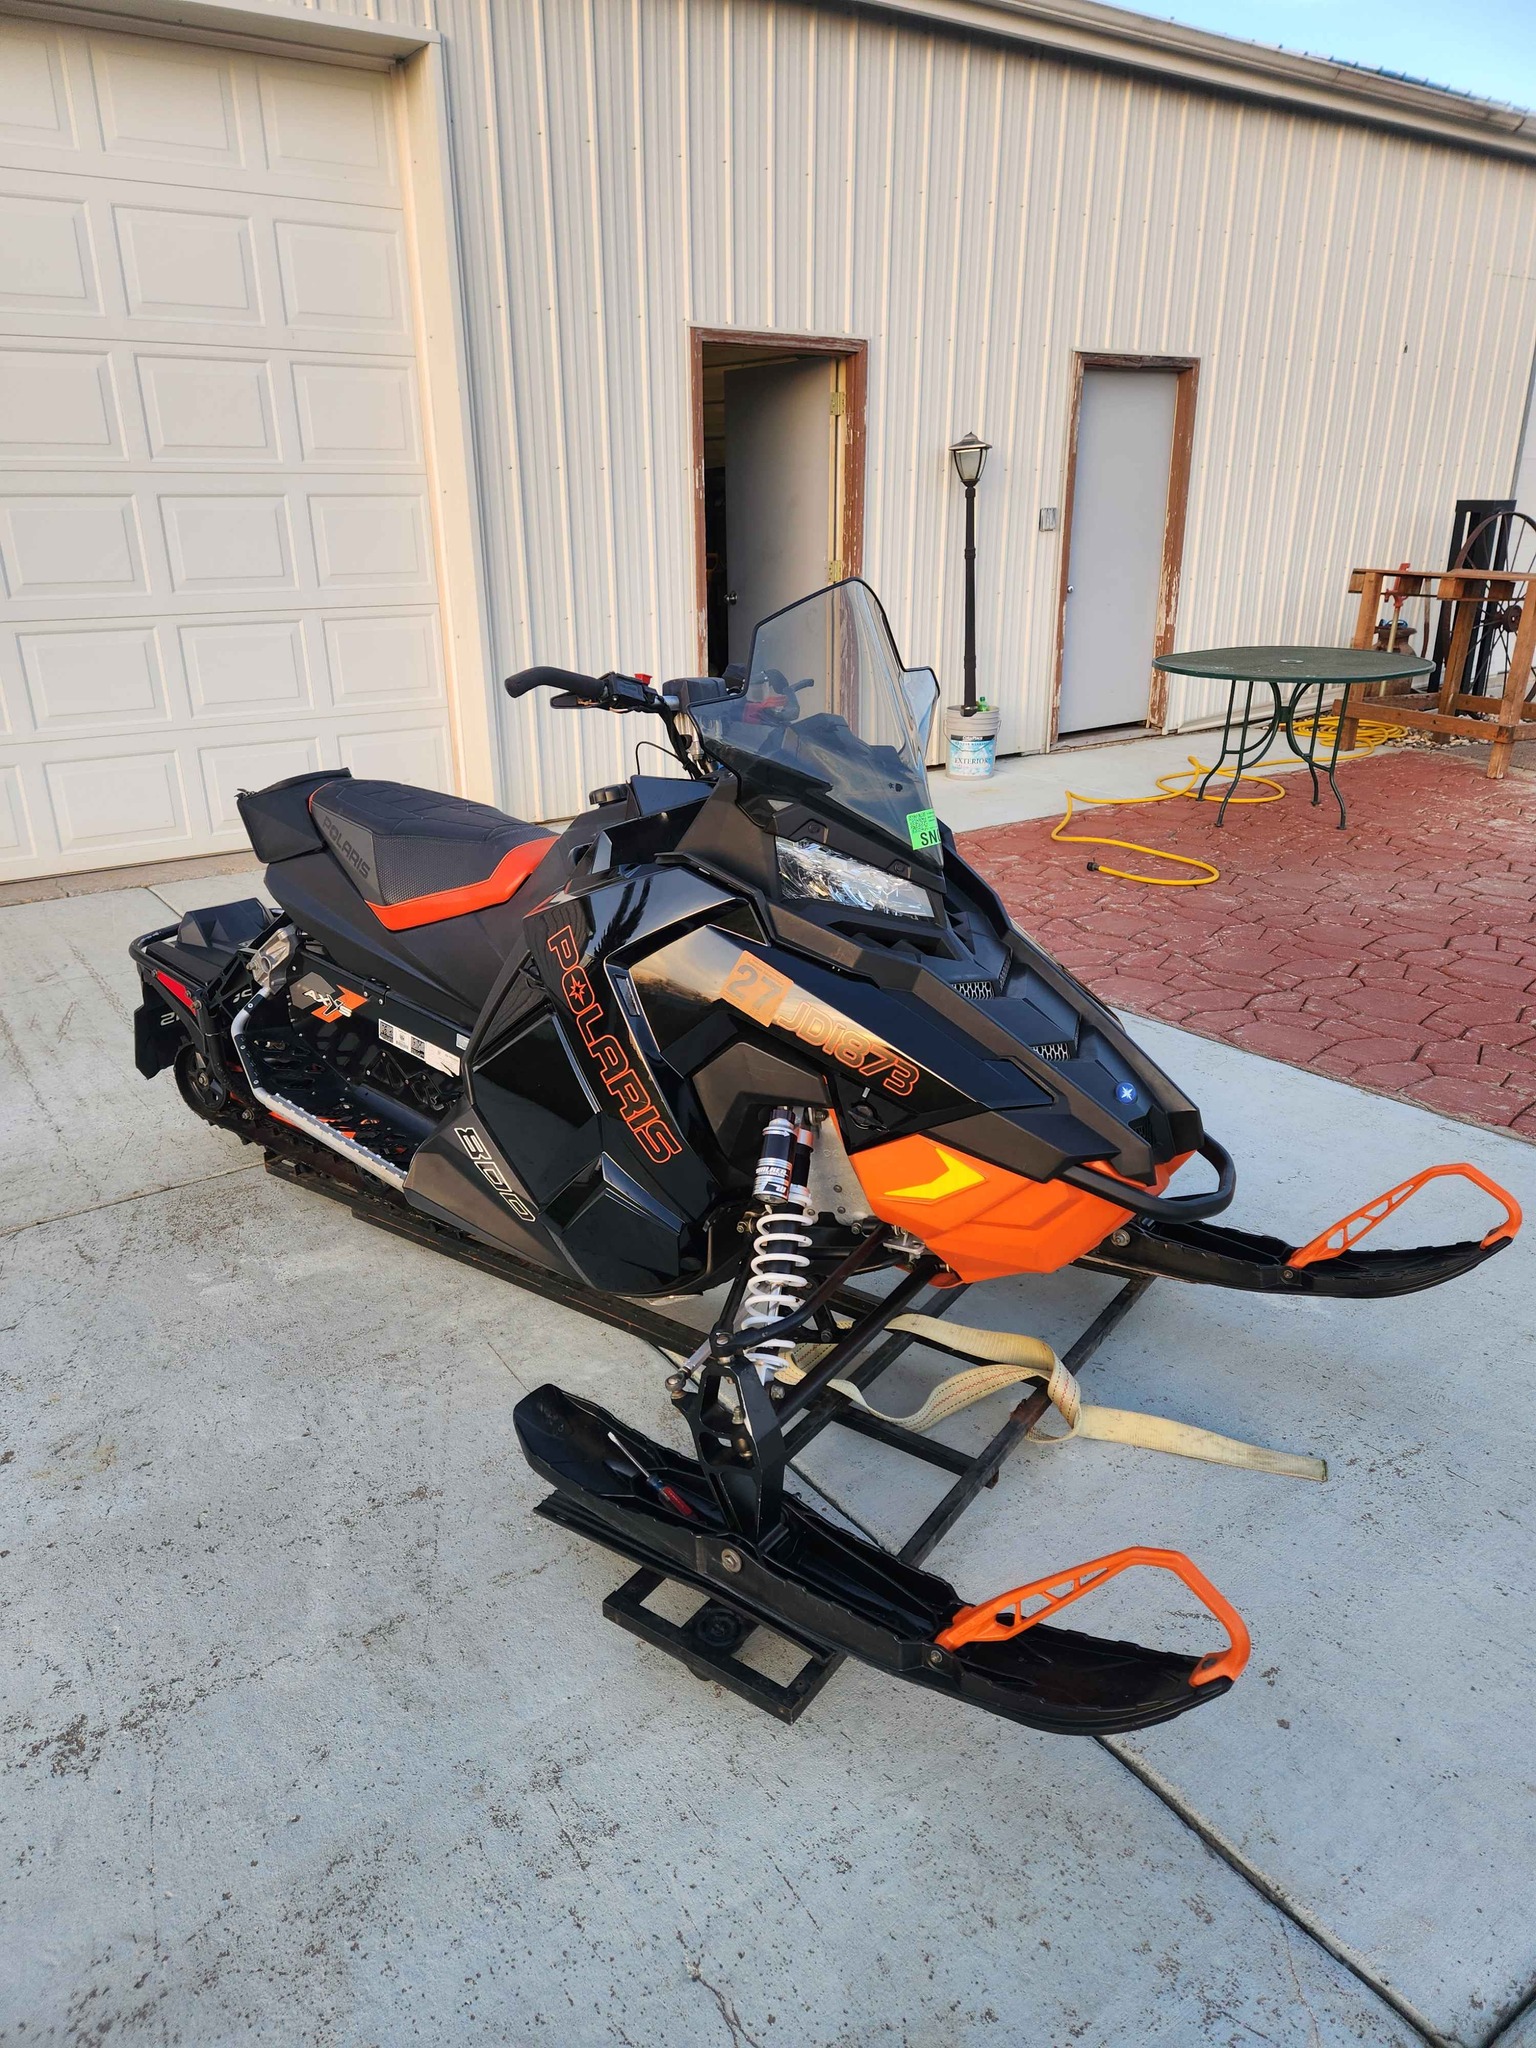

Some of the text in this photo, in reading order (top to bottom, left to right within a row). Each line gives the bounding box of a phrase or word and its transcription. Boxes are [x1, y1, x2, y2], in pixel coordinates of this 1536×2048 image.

[322, 816, 371, 879] POLARIS
[727, 964, 783, 1010] 27
[547, 925, 683, 1163] POLARIS
[453, 1127, 536, 1222] 800
